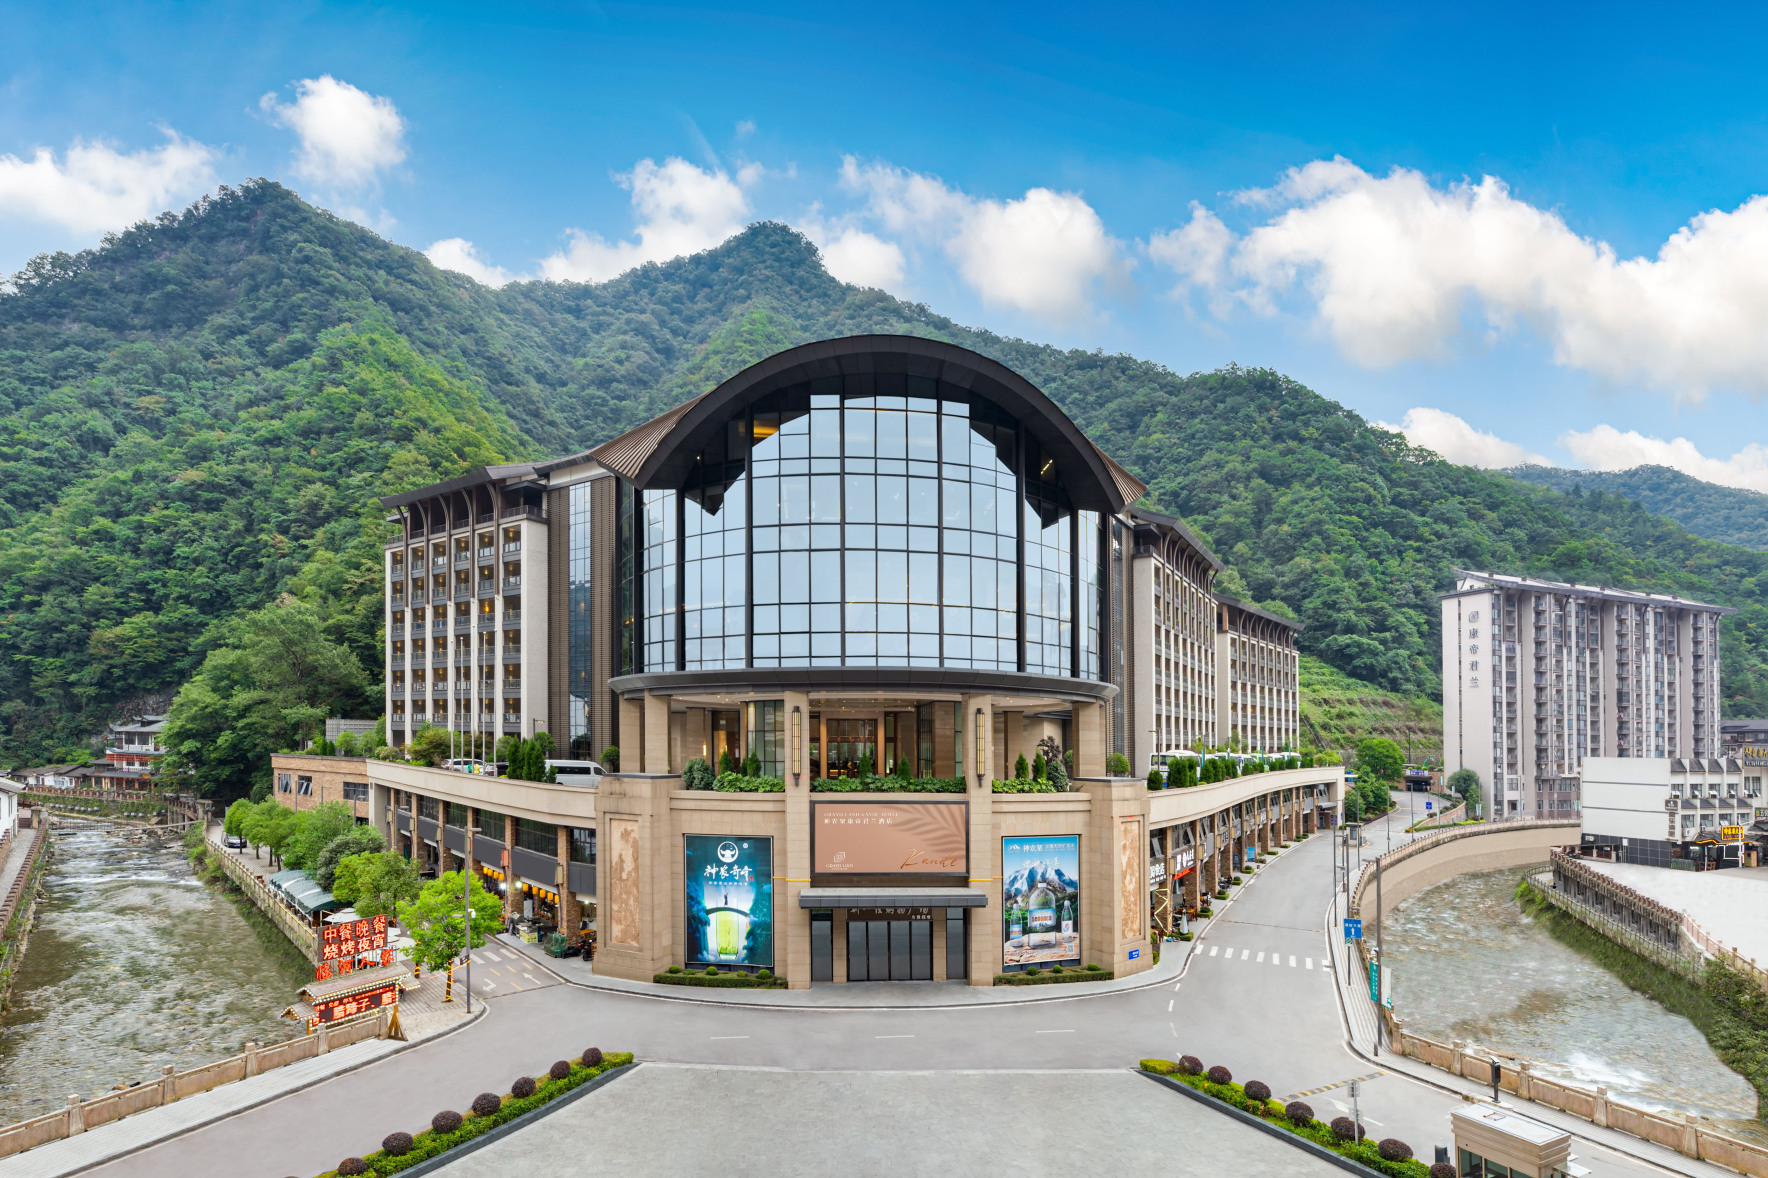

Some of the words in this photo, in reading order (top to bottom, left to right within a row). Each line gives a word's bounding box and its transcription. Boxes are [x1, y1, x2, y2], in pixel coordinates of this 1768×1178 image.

[1468, 627, 1480, 688] 康帝君兰
[900, 848, 959, 870] Kande
[323, 915, 386, 943] 中餐晚餐
[323, 933, 386, 960] 烧烤夜宵
[315, 948, 395, 982] 临河人家
